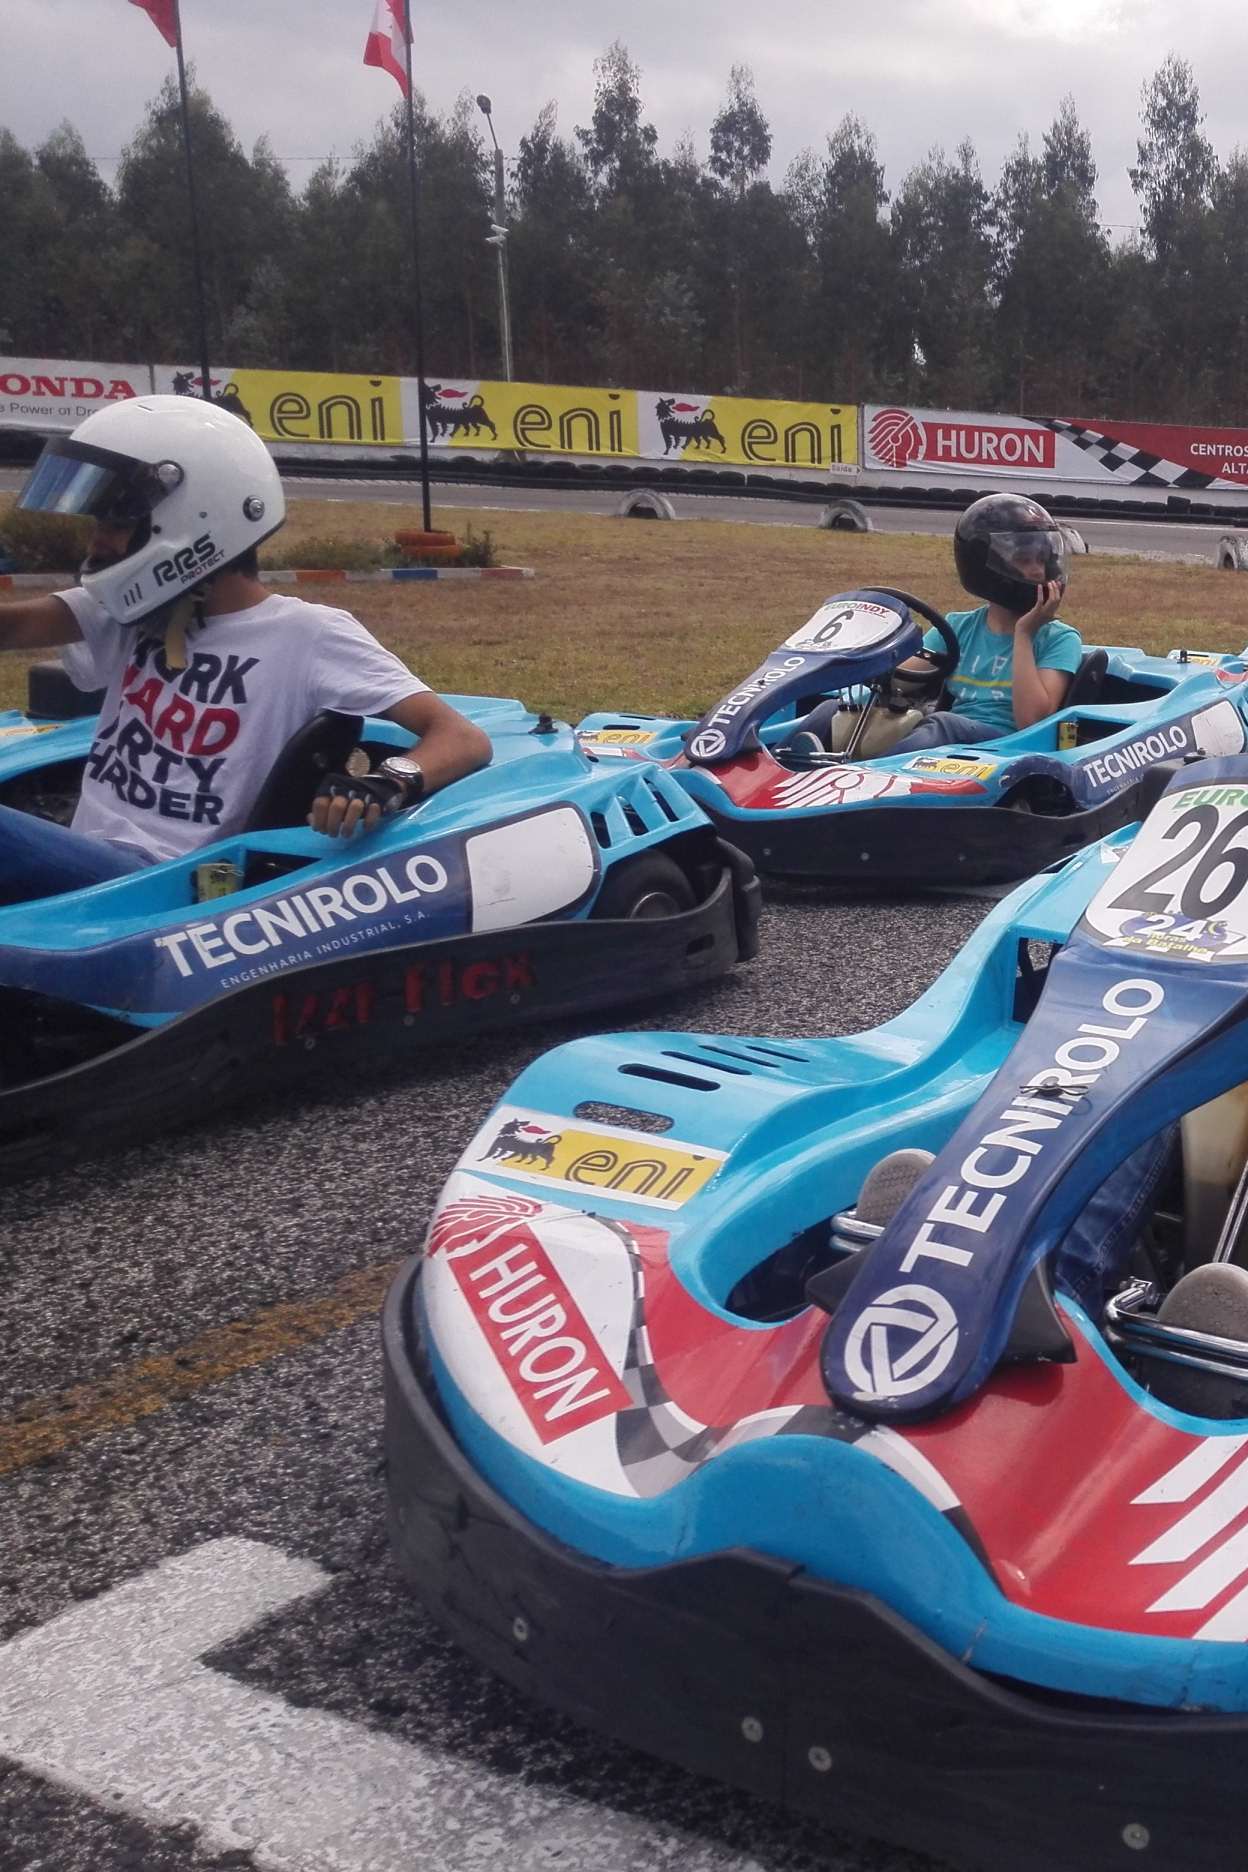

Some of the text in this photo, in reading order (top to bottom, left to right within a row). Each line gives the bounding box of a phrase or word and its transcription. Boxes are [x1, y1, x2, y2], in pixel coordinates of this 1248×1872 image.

[10, 402, 53, 417] Power
[58, 405, 71, 415] of
[270, 379, 386, 441] eni
[513, 393, 622, 452] eni
[741, 408, 842, 465] eni
[936, 428, 1045, 464] HURON
[152, 532, 216, 587] RRS
[180, 548, 225, 584] PROTECT
[813, 610, 854, 644] 6
[707, 656, 805, 728] TECNIROLO
[97, 701, 226, 793] RTY
[940, 763, 993, 777] eni
[1082, 725, 1188, 788] TECNIROLO
[87, 741, 223, 825] HARDER
[154, 853, 448, 978] TECNIROLO
[1133, 914, 1208, 941] 24
[220, 950, 313, 989] ENGENHARIA
[1146, 938, 1209, 954] Batalha
[899, 978, 1165, 1273] TECNIROLO
[564, 1149, 706, 1200] eni
[469, 1243, 611, 1422] HURON
